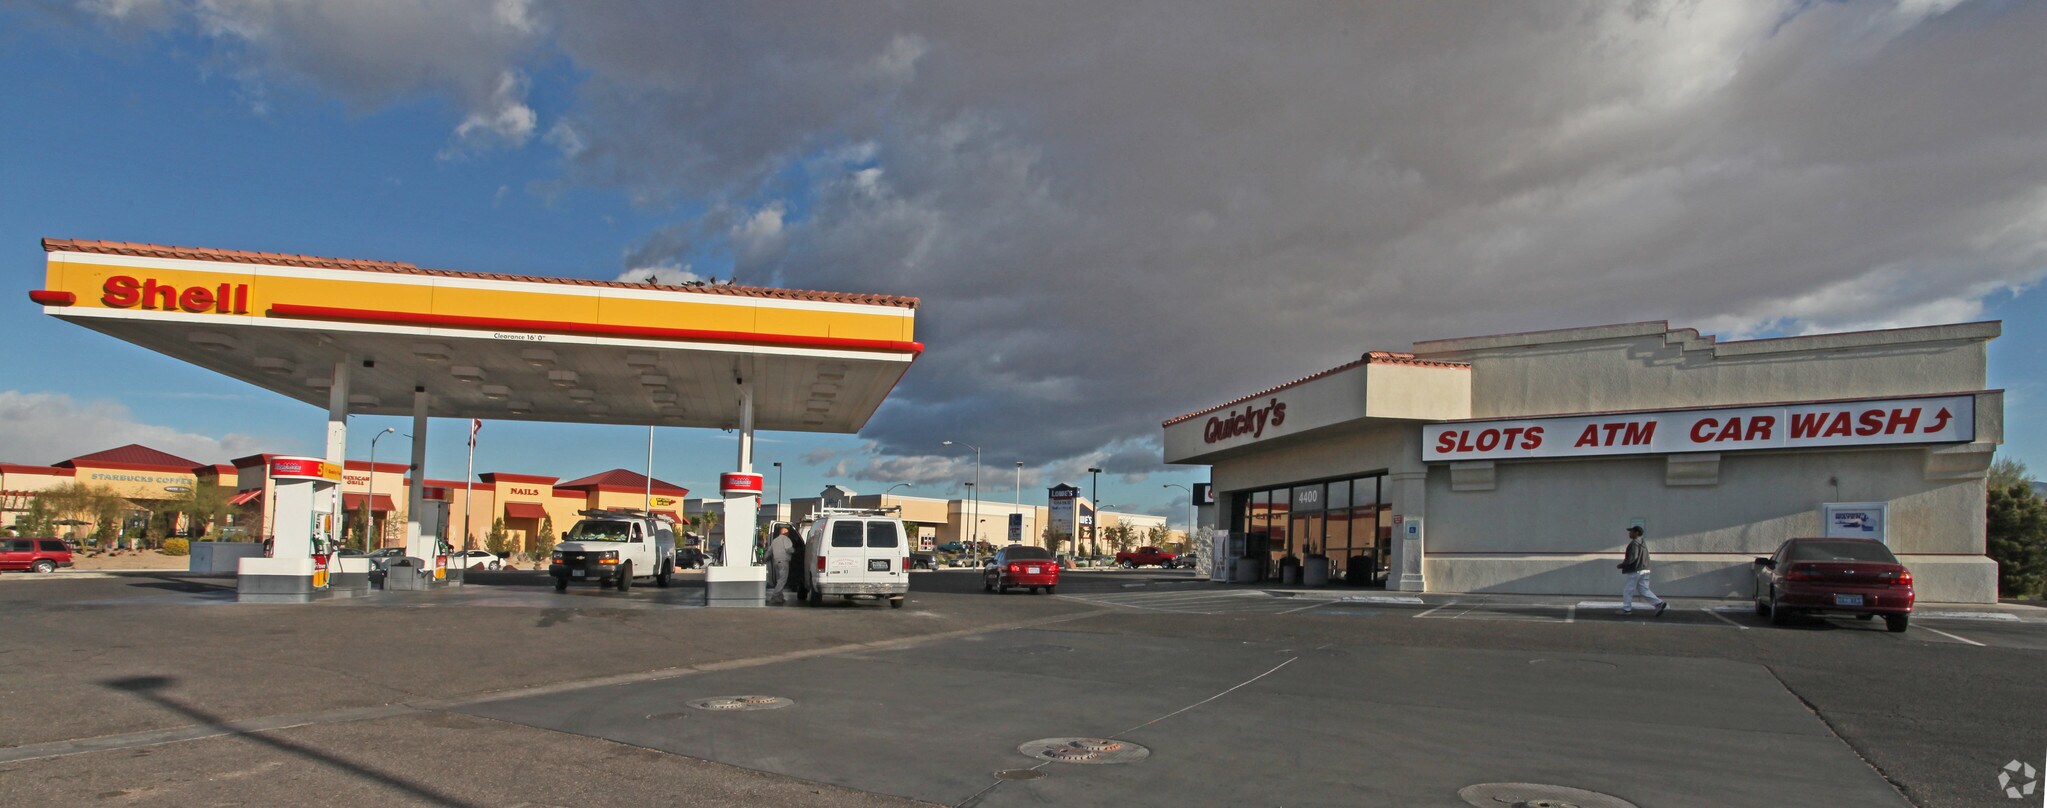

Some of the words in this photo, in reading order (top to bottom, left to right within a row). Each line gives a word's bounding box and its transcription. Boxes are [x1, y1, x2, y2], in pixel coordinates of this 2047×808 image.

[101, 275, 249, 313] Shell
[493, 332, 526, 340] Clearance
[1204, 398, 1287, 444] Quicky's
[1435, 426, 1544, 454] SLOTS
[1574, 421, 1657, 448] ATM
[1689, 415, 1776, 443] CAR
[1790, 408, 1922, 438] WASH
[91, 473, 154, 483] STARBUCKS
[155, 477, 193, 485] COFFEE
[510, 487, 539, 496] NAILS
[1299, 489, 1318, 503] 4400
